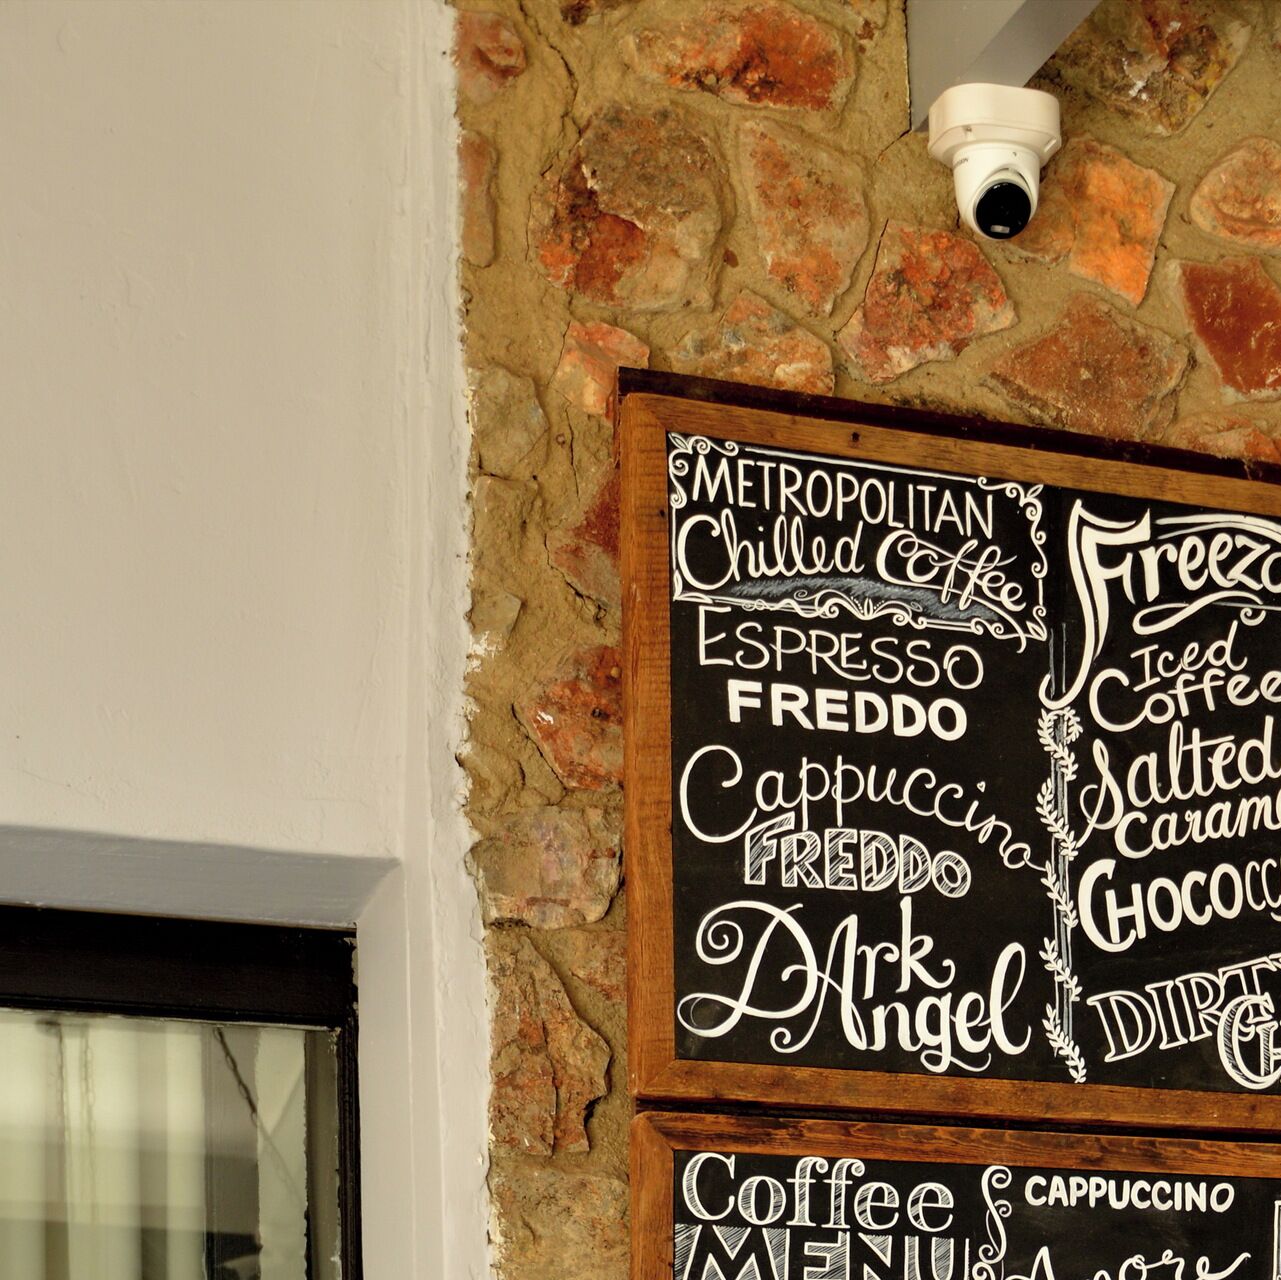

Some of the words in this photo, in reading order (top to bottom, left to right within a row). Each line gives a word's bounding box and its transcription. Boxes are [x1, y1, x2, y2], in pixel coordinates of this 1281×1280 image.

[692, 455, 994, 539] METROPOLITAN
[676, 509, 865, 591] Chilled
[875, 530, 1026, 630] Coffee
[697, 607, 984, 689] ESPRESSO
[1131, 620, 1247, 692] Iced
[727, 680, 967, 740] FREDDO
[680, 745, 1046, 870] Cappuccino
[744, 812, 971, 897] FREDDO
[682, 1152, 955, 1232] Coffee
[1024, 1175, 1235, 1213] CAPPUCCINO
